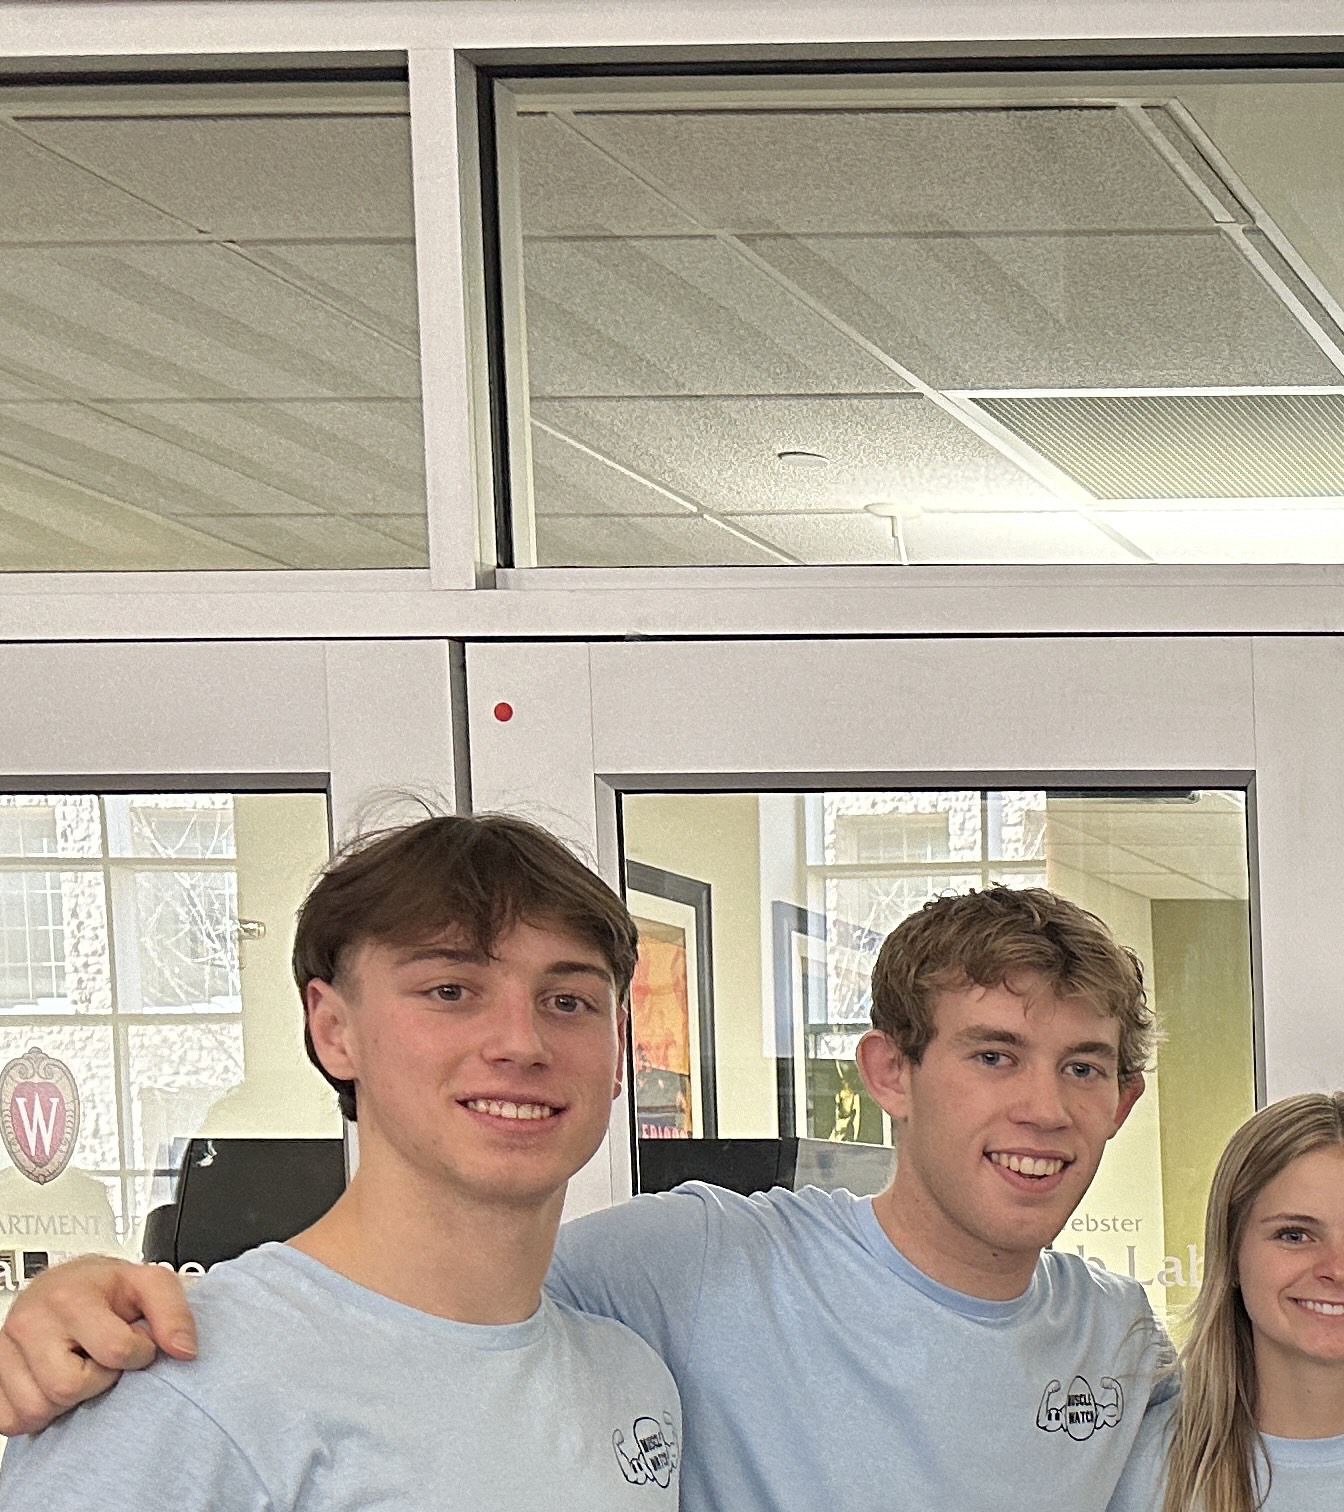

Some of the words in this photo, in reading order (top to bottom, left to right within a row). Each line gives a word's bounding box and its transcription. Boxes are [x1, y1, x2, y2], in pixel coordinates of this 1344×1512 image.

[15, 1096, 60, 1158] W
[115, 1214, 142, 1236] OF
[1071, 1213, 1143, 1232] ebster
